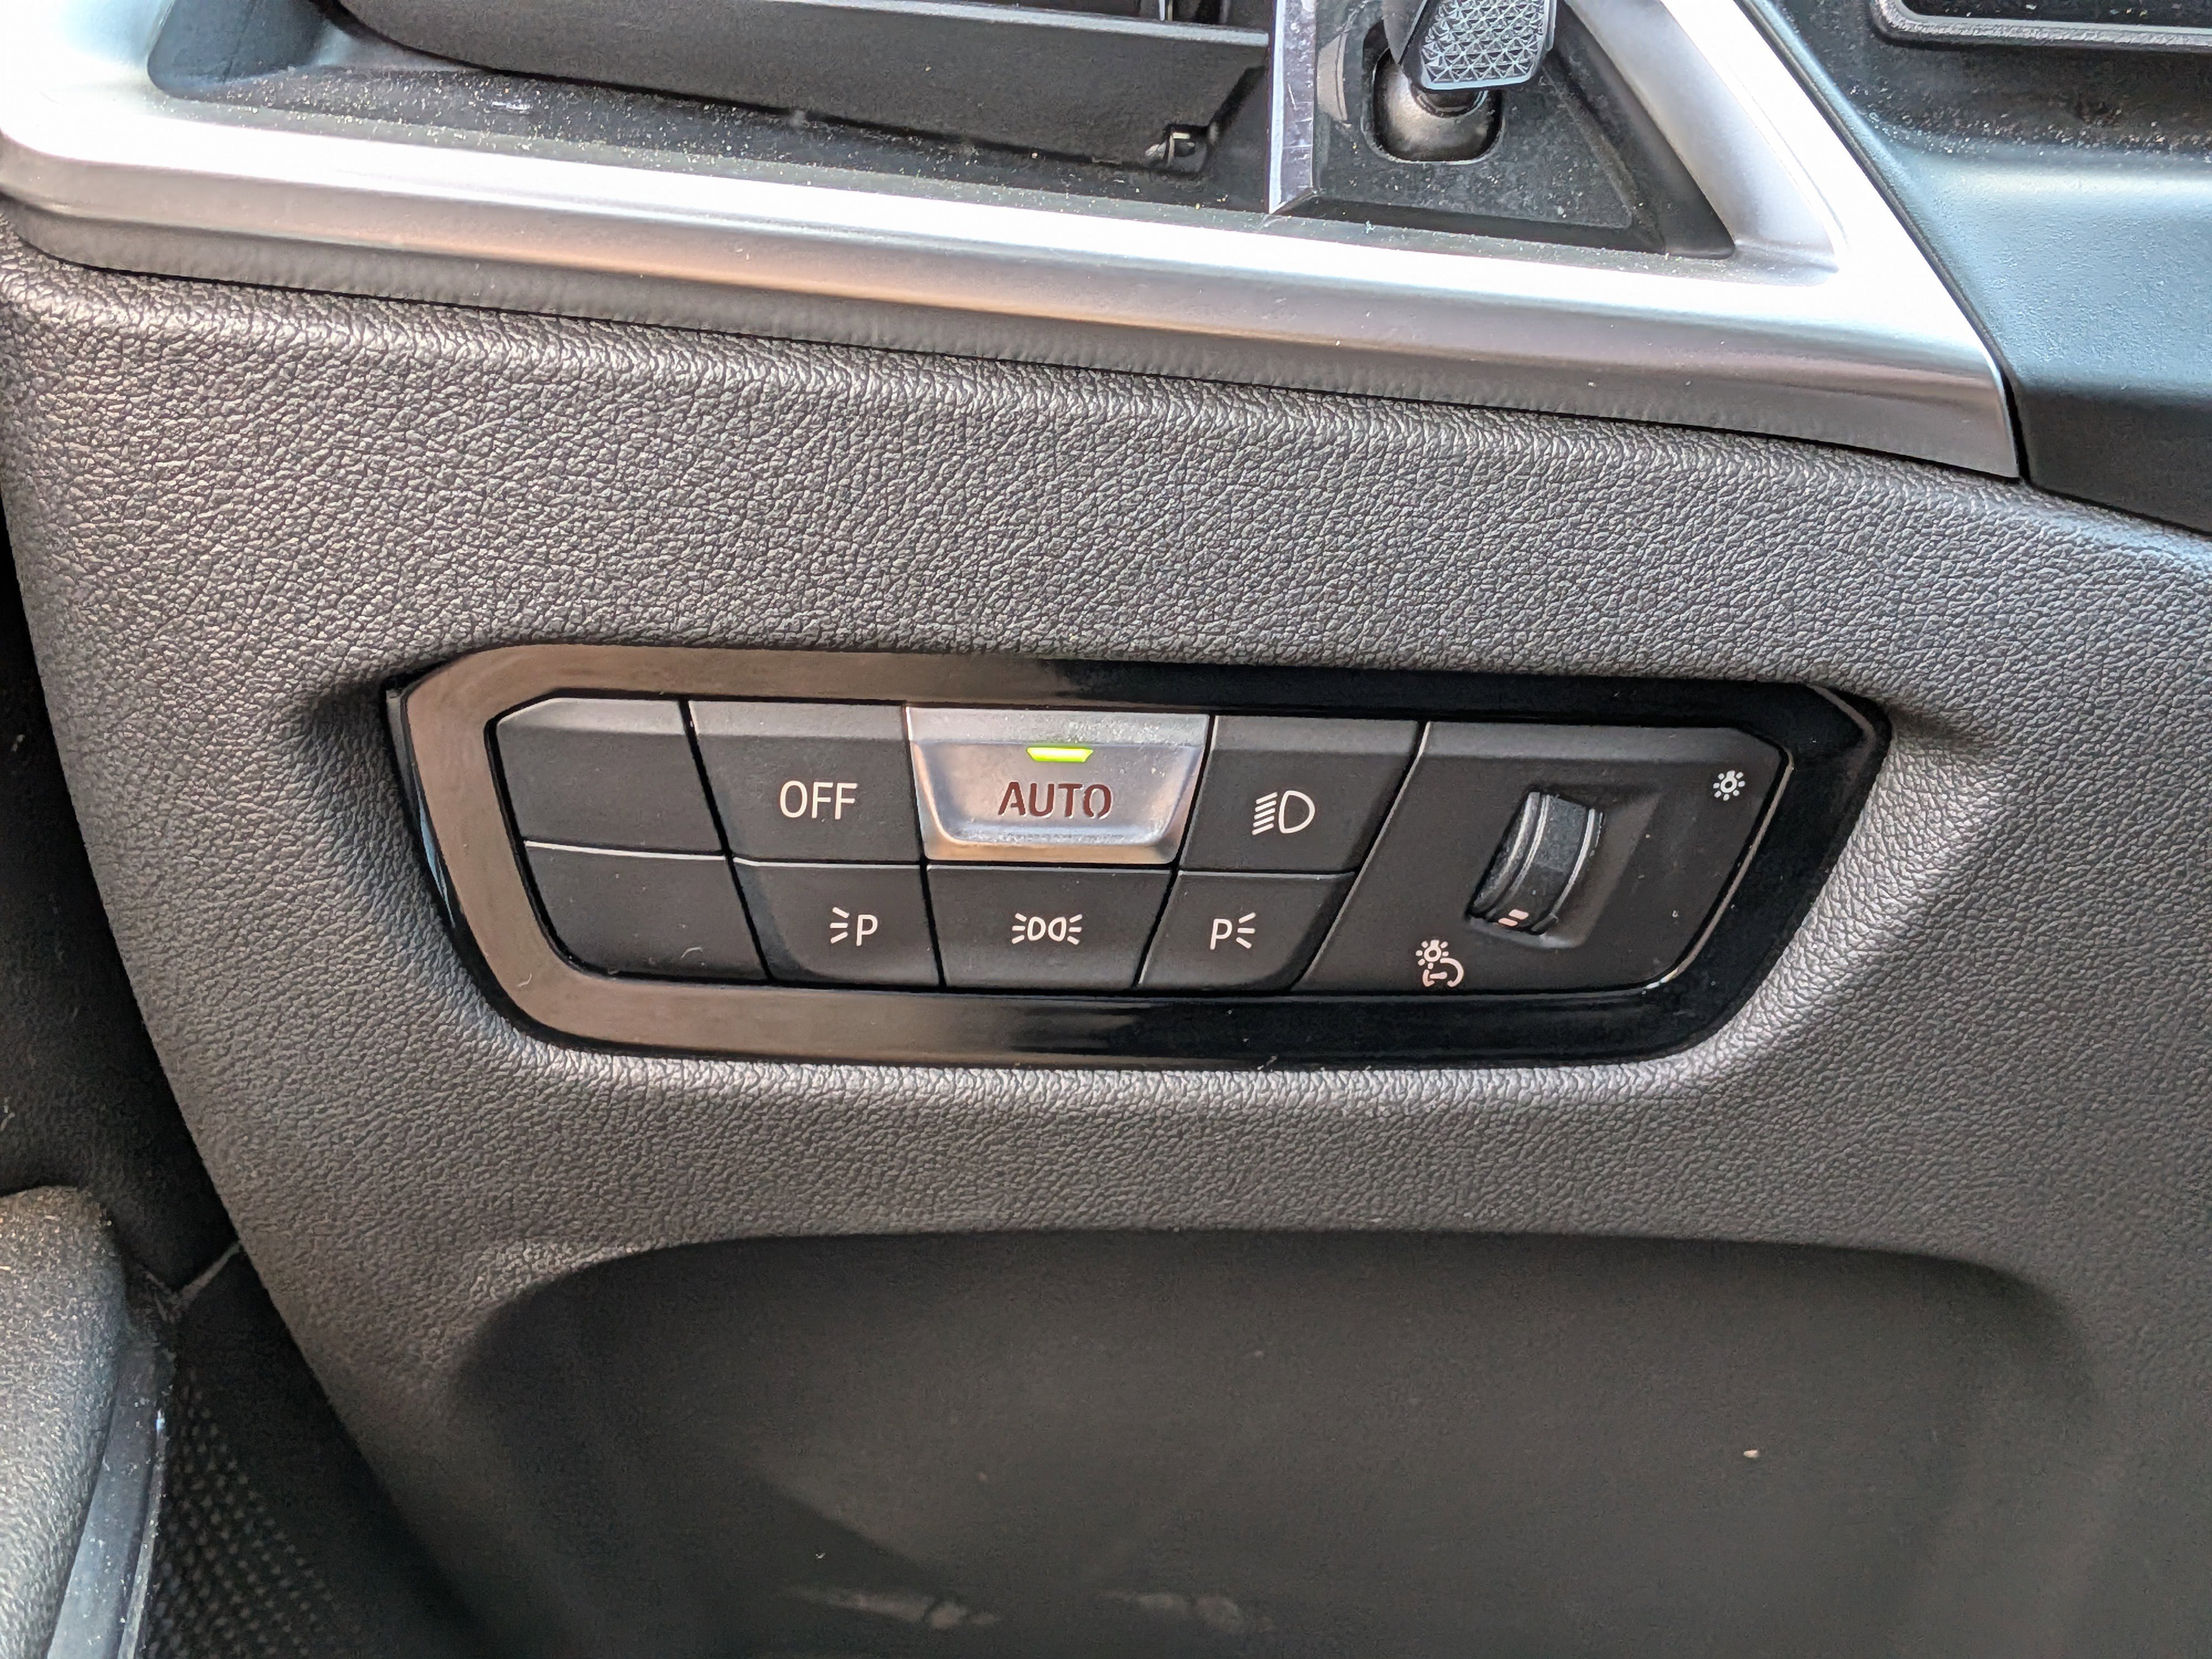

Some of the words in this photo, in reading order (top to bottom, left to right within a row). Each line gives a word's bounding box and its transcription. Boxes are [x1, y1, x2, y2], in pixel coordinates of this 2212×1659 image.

[779, 780, 858, 820] OFF
[998, 781, 1113, 819] AUTO
[856, 914, 878, 946] P
[1210, 918, 1233, 950] P
